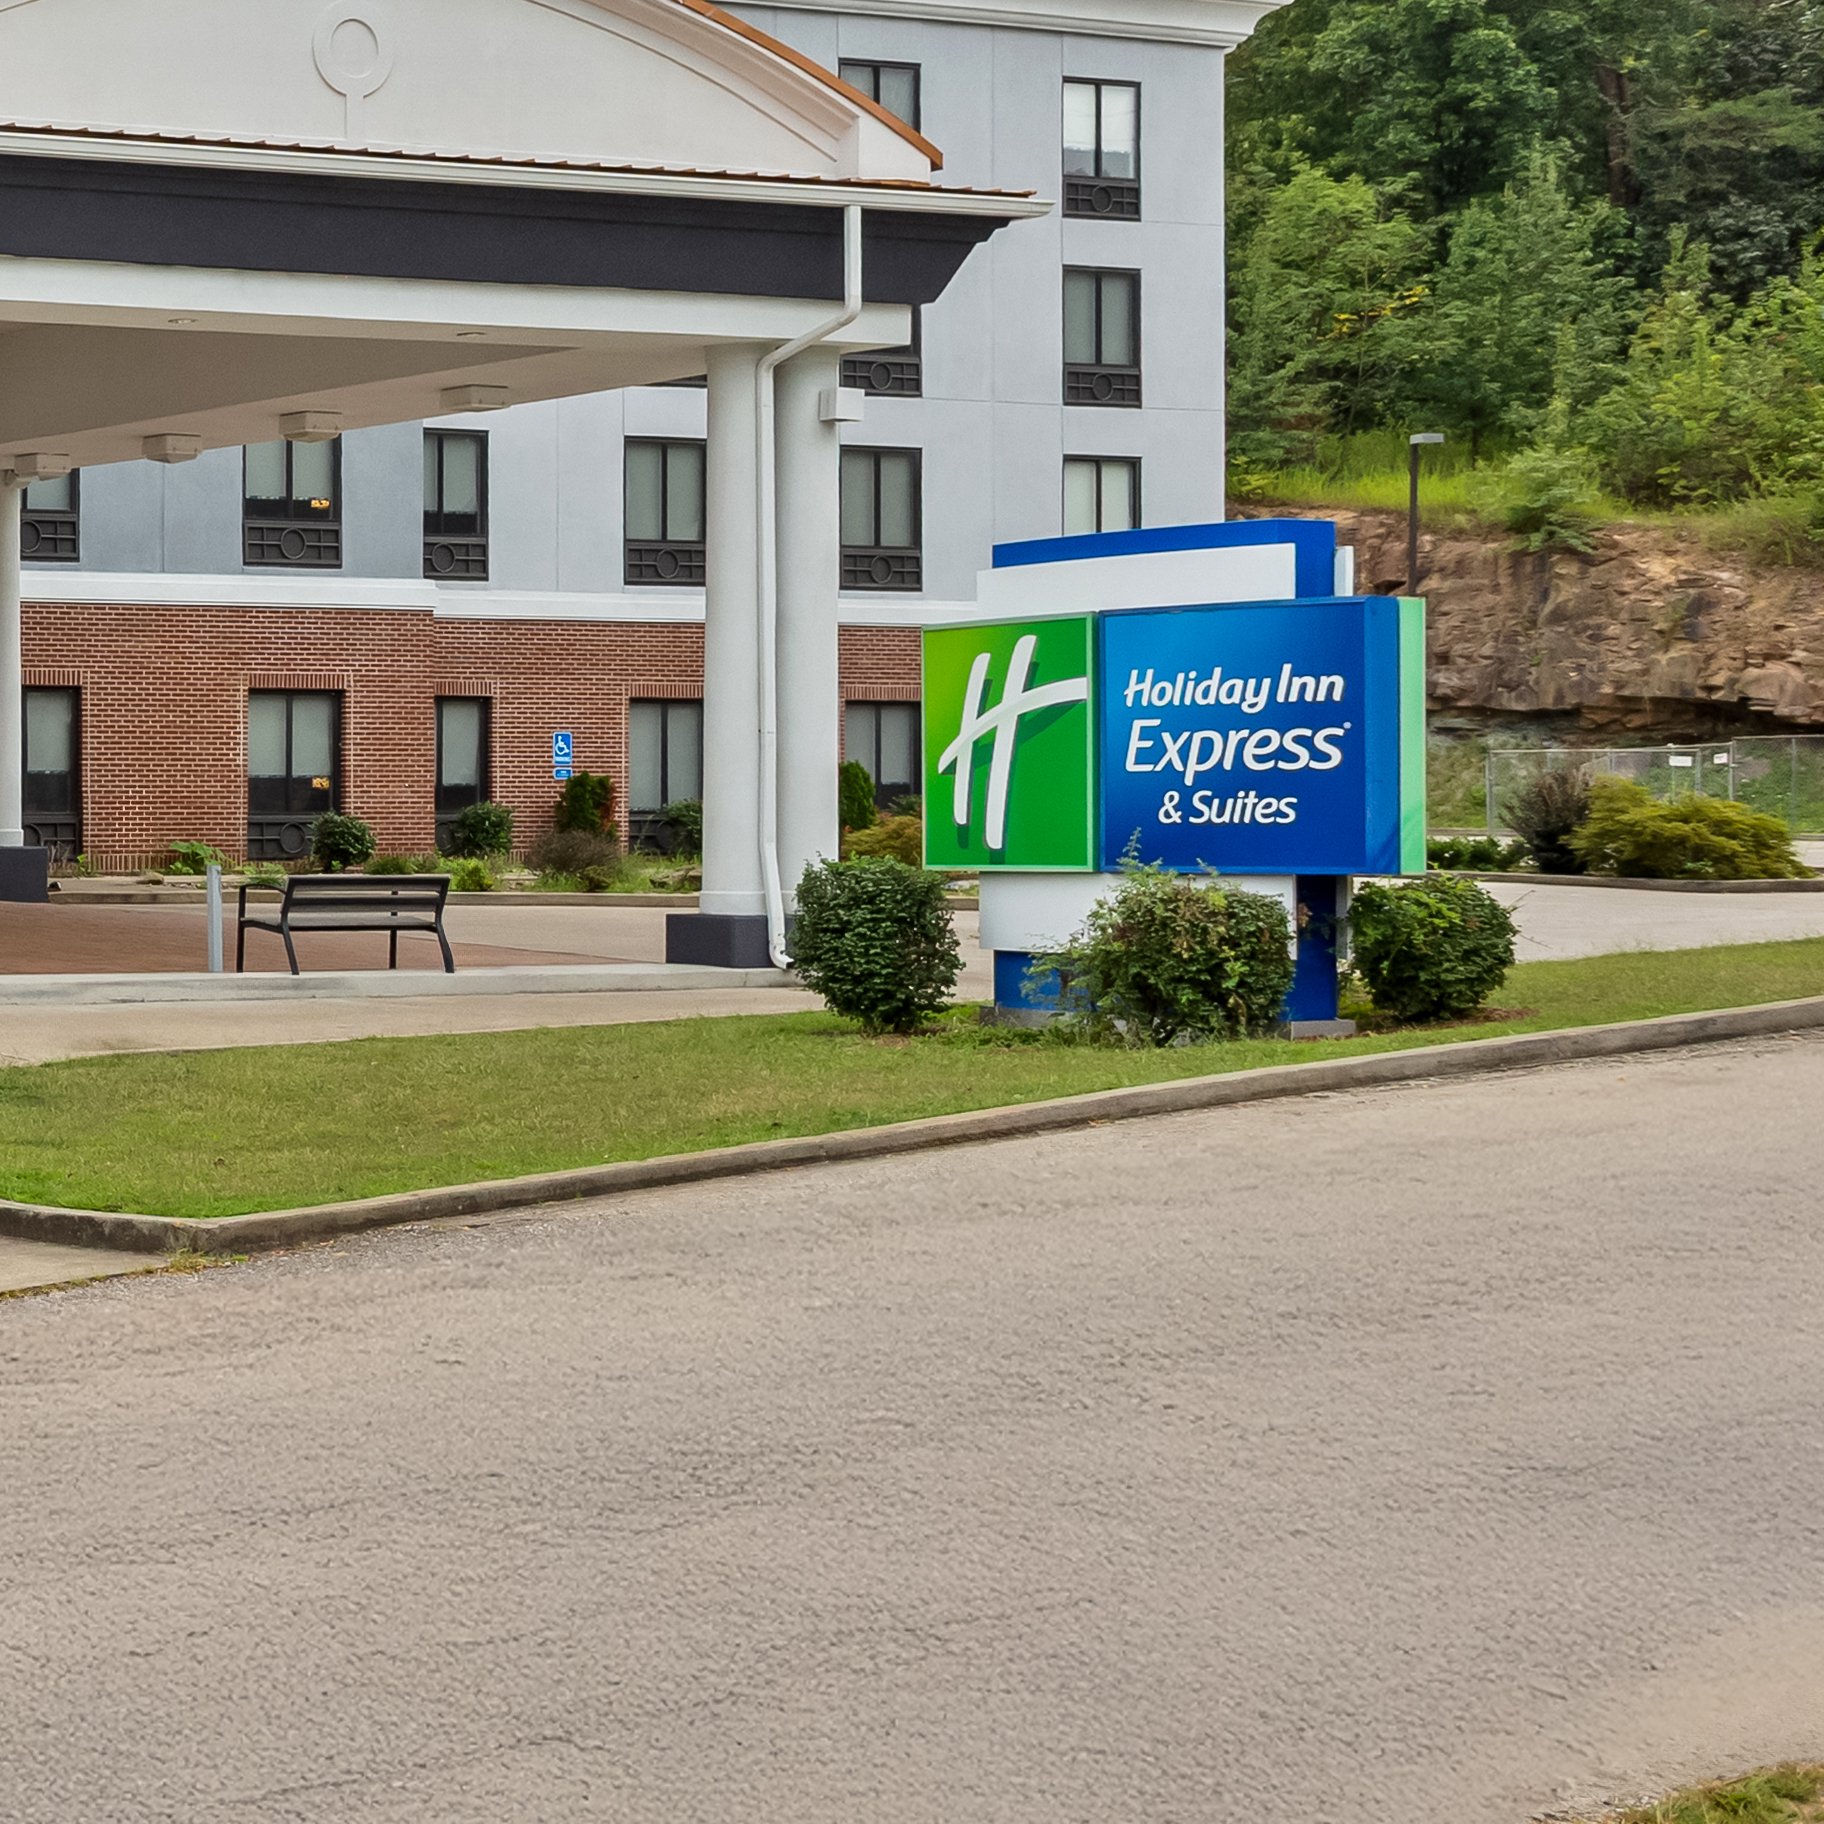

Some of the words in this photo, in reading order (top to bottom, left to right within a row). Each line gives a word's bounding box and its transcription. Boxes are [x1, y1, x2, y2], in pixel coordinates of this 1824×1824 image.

[1123, 666, 1272, 714] Holiday
[1276, 663, 1345, 703] Inn
[1125, 718, 1346, 787] Express
[1158, 790, 1183, 824] &
[1188, 789, 1298, 824] Suites
